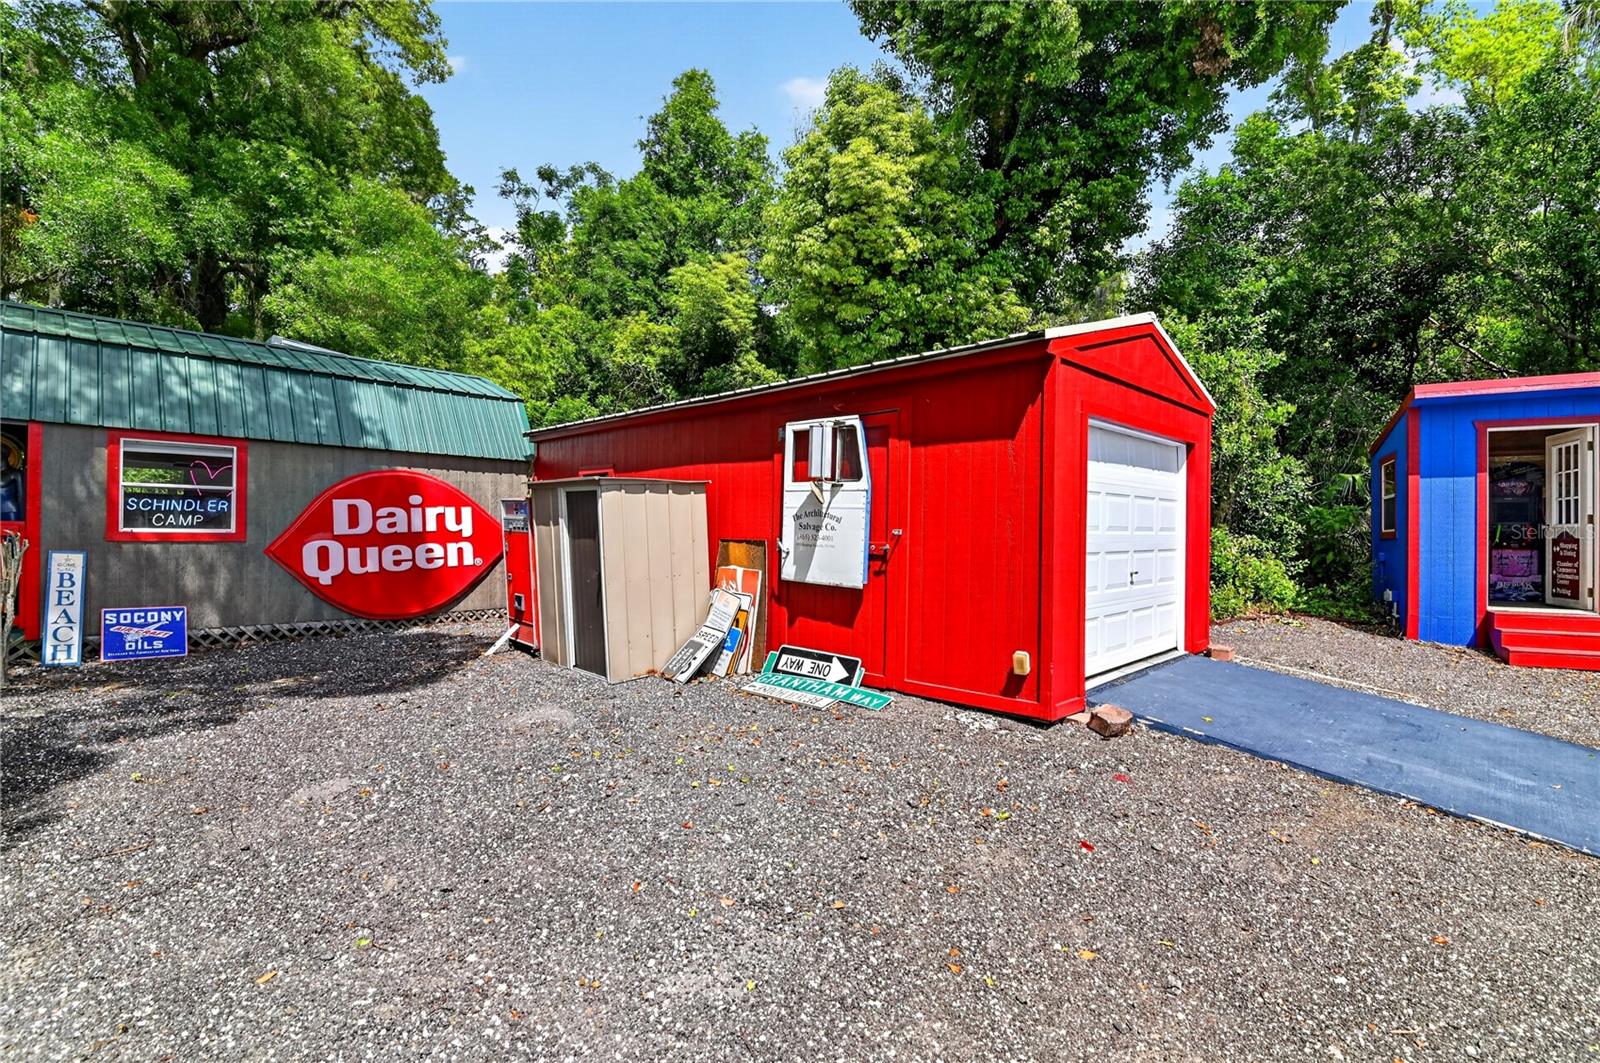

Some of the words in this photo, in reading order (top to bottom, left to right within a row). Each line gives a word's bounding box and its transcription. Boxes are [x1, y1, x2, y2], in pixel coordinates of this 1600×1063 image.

[126, 497, 229, 512] SCHINDLER
[152, 512, 204, 526] CAMP
[331, 494, 473, 538] Dairy
[798, 521, 823, 532] Salvage
[825, 523, 837, 531] Co.
[50, 571, 77, 662] BEACH
[105, 610, 184, 624] SOCONY
[696, 630, 719, 643] SPEED
[125, 640, 163, 650] OILS
[781, 656, 804, 671] WAY
[807, 661, 832, 677] ONE
[757, 673, 850, 699] GRANTHAM
[849, 693, 884, 707] WAY
